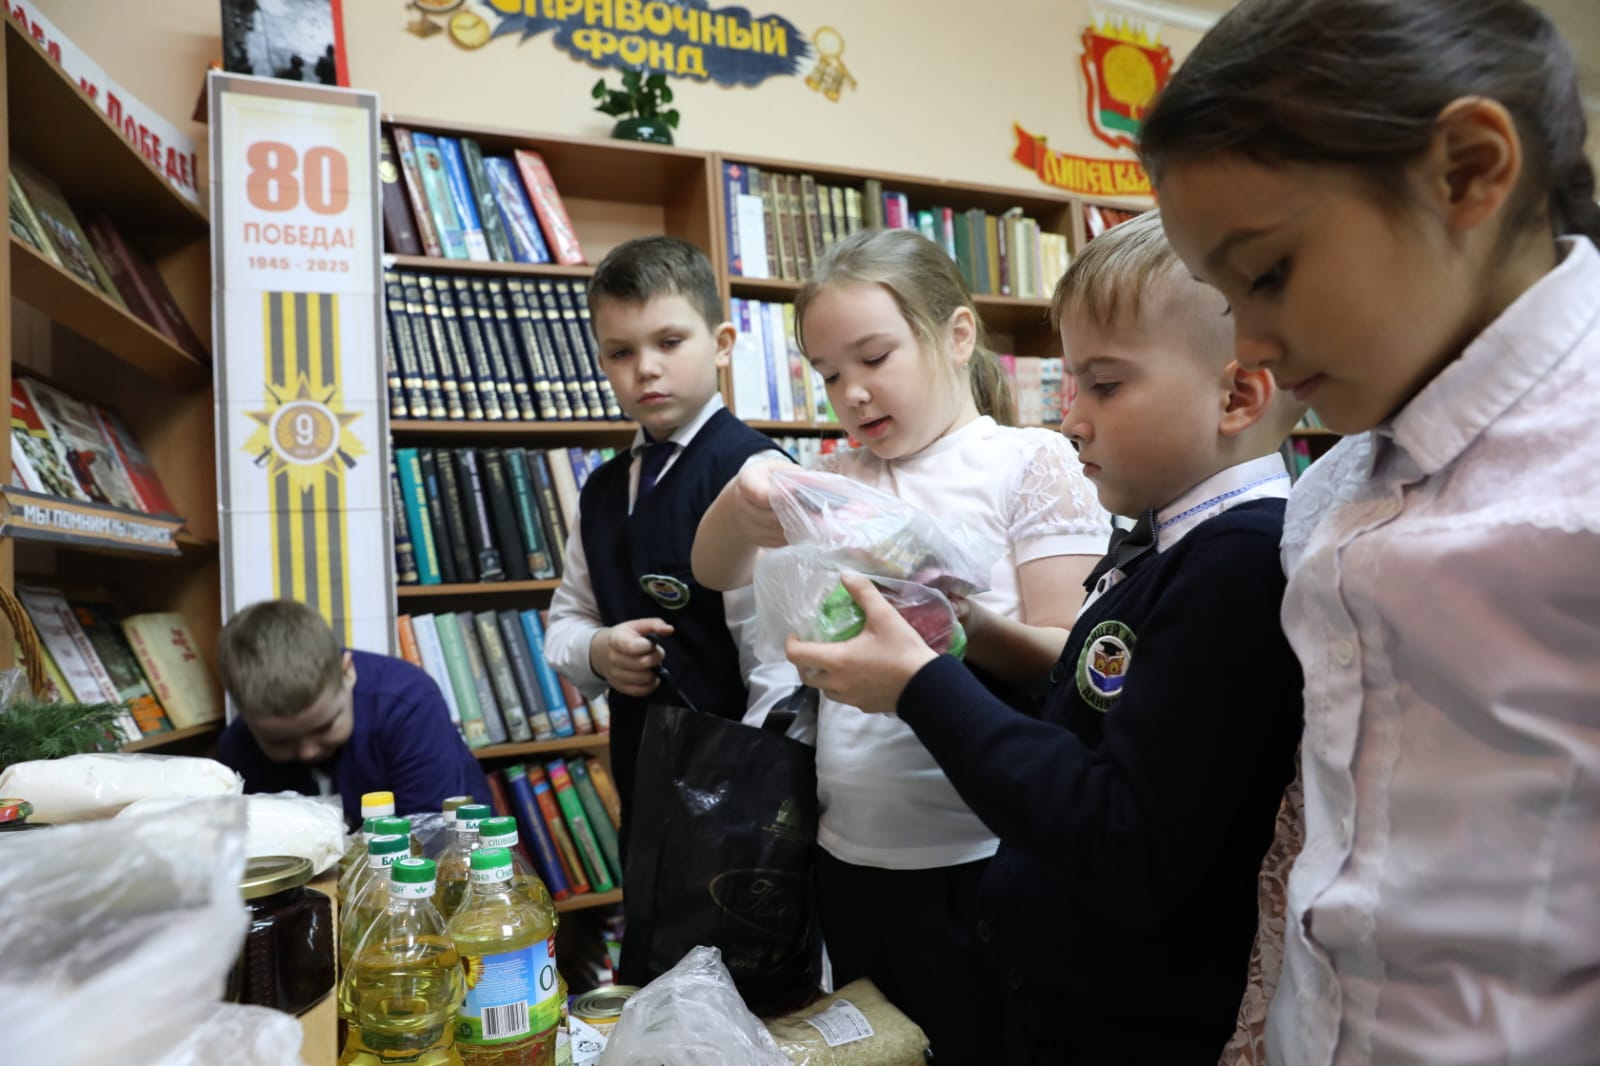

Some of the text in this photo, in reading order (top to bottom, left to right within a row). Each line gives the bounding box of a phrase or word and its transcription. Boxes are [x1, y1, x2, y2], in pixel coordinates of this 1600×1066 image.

[572, 28, 708, 78] ФОНД
[246, 140, 350, 216] 80
[243, 221, 355, 252] ПОБЕДА!
[248, 255, 290, 271] 1945
[305, 257, 350, 273] 2025
[296, 414, 314, 446] 9
[23, 504, 50, 526] МЫ
[53, 508, 112, 533] ПОМНИМ
